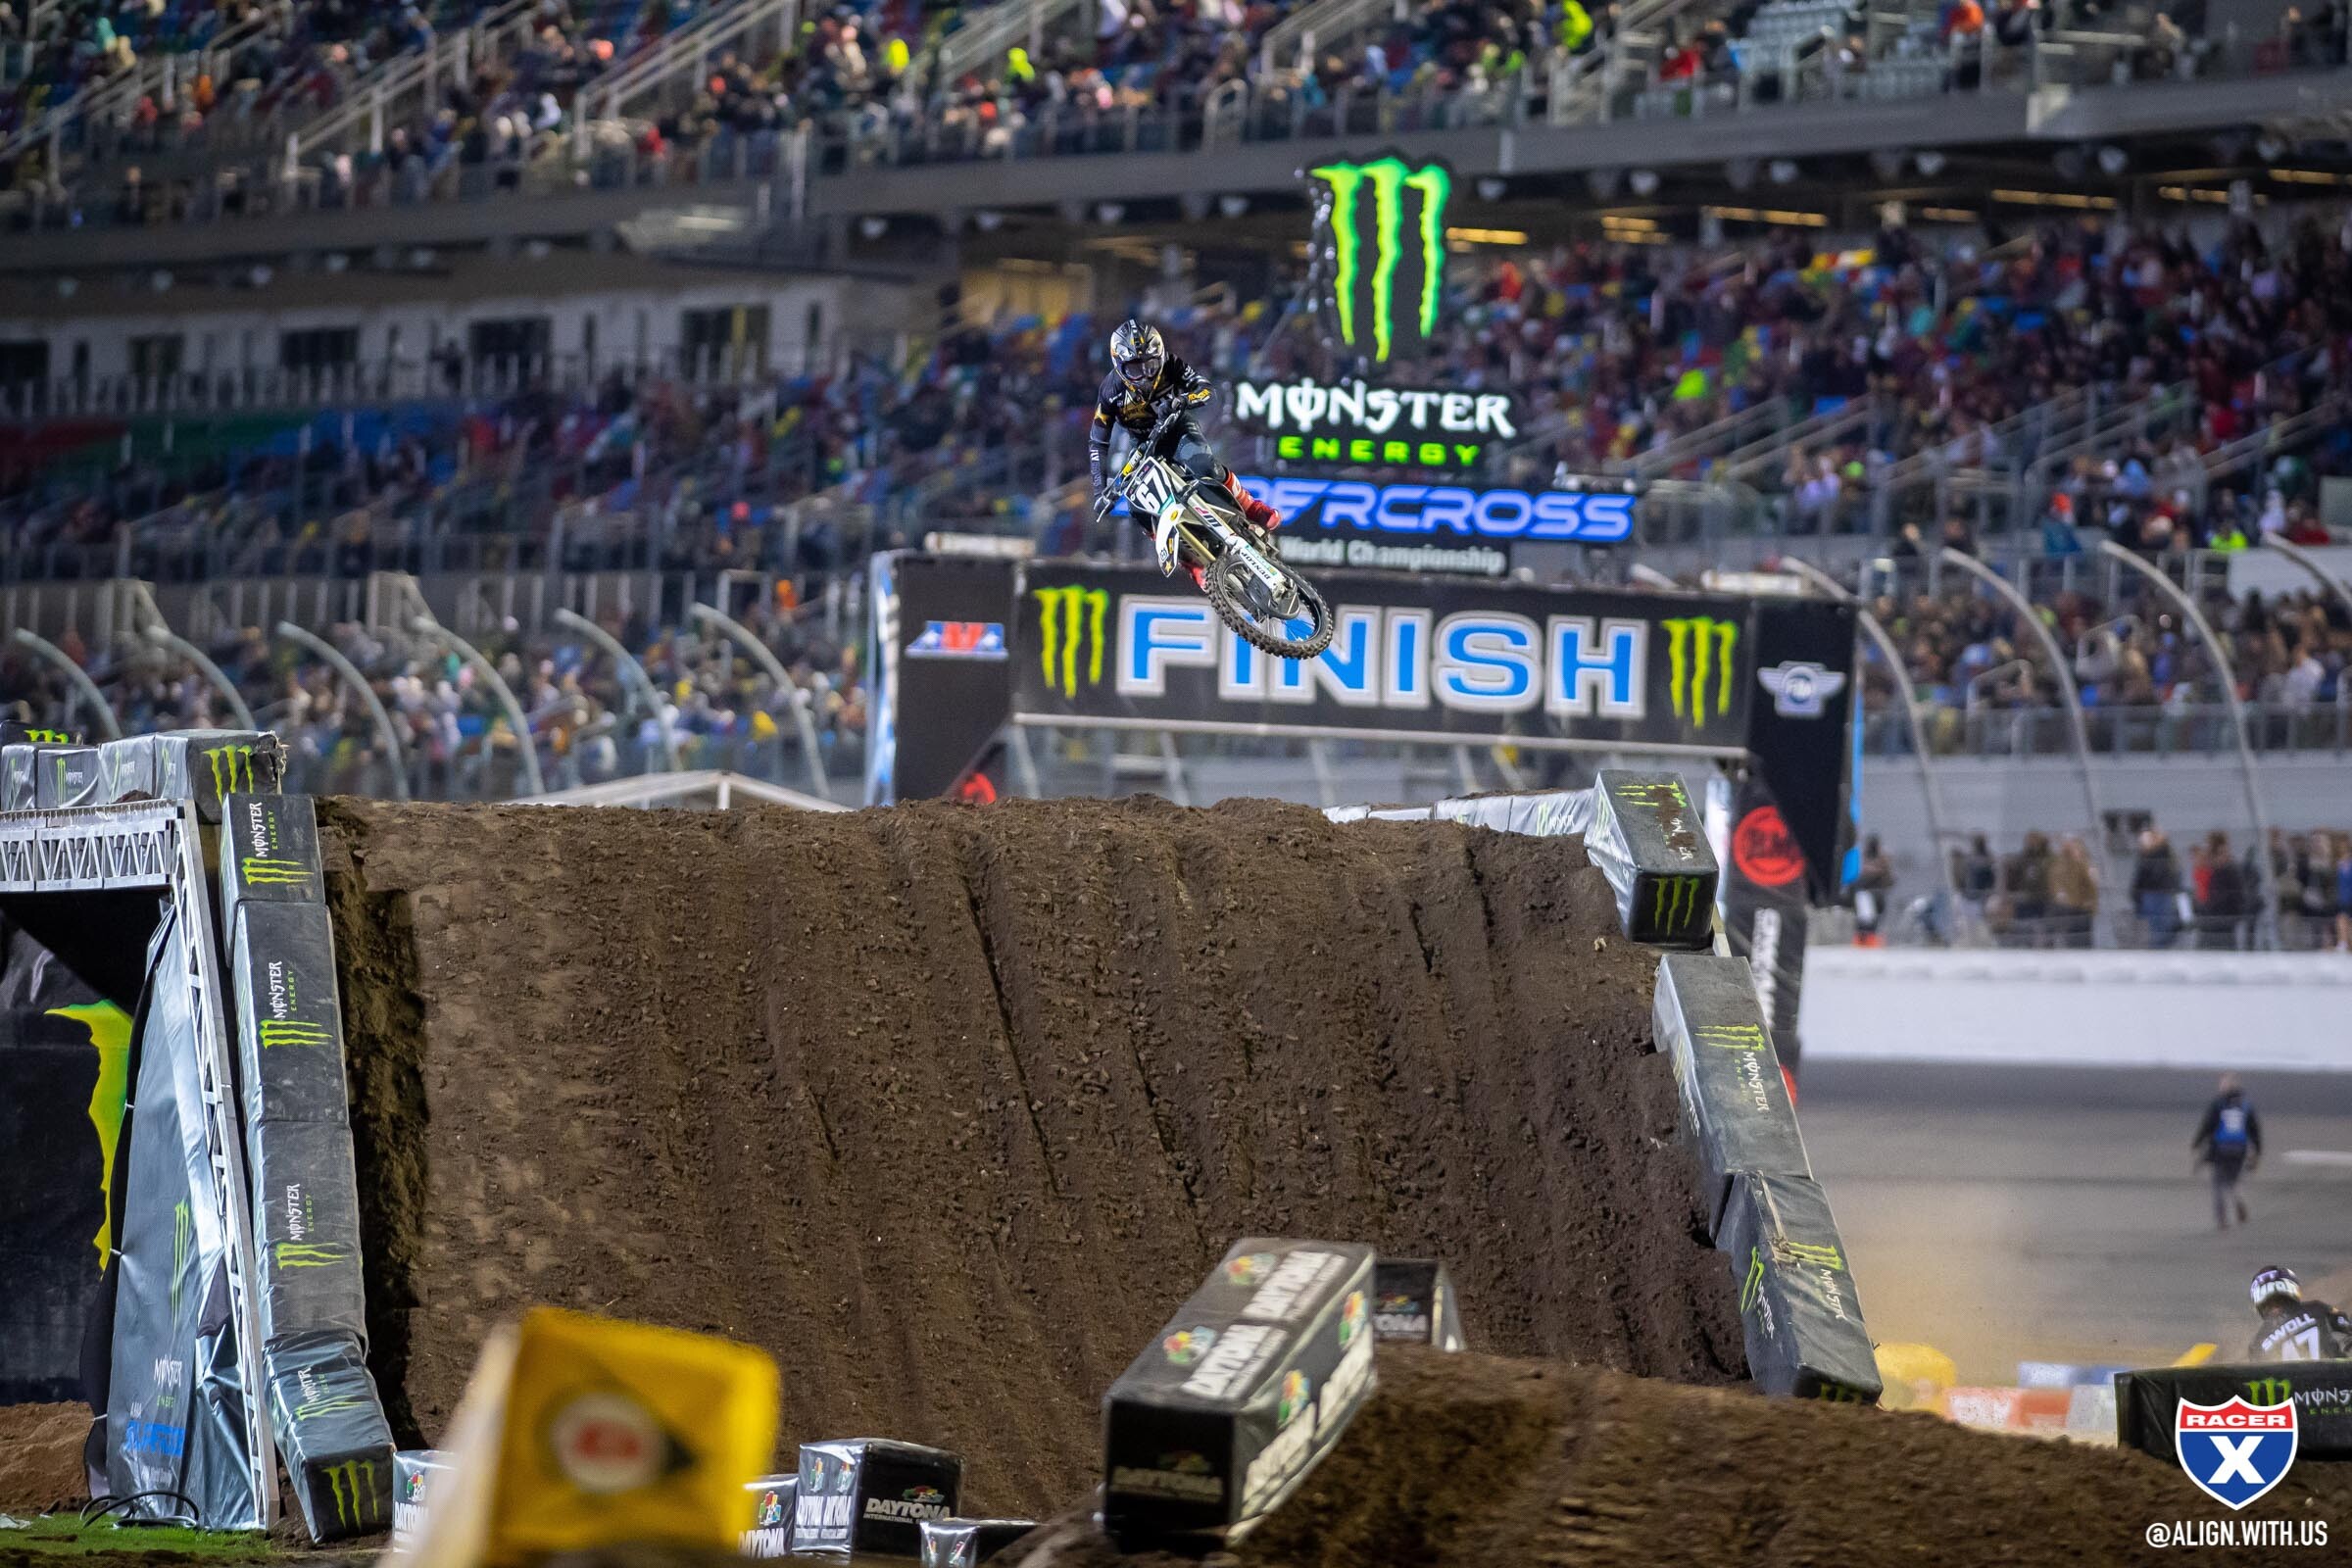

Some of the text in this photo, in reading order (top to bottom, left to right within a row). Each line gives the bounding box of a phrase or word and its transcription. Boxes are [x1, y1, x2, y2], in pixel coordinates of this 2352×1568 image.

[1237, 378, 1516, 438] MONSTER
[1279, 435, 1480, 466] ENERGY
[1136, 466, 1169, 514] 67
[1348, 542, 1505, 576] Championship
[1117, 593, 1648, 720] FINISH
[249, 802, 270, 858] MONSTER
[268, 810, 278, 850] ENERGY
[268, 960, 288, 1020] MONSTER
[287, 970, 297, 1011] ENERGY
[1742, 1051, 1771, 1111] MONSTER
[285, 1183, 306, 1241] MONSTER
[305, 1193, 315, 1233] ENERGY
[2262, 1313, 2317, 1351] SWOLL
[2294, 1388, 2352, 1406] MONS
[864, 1497, 951, 1521] DAYTONA
